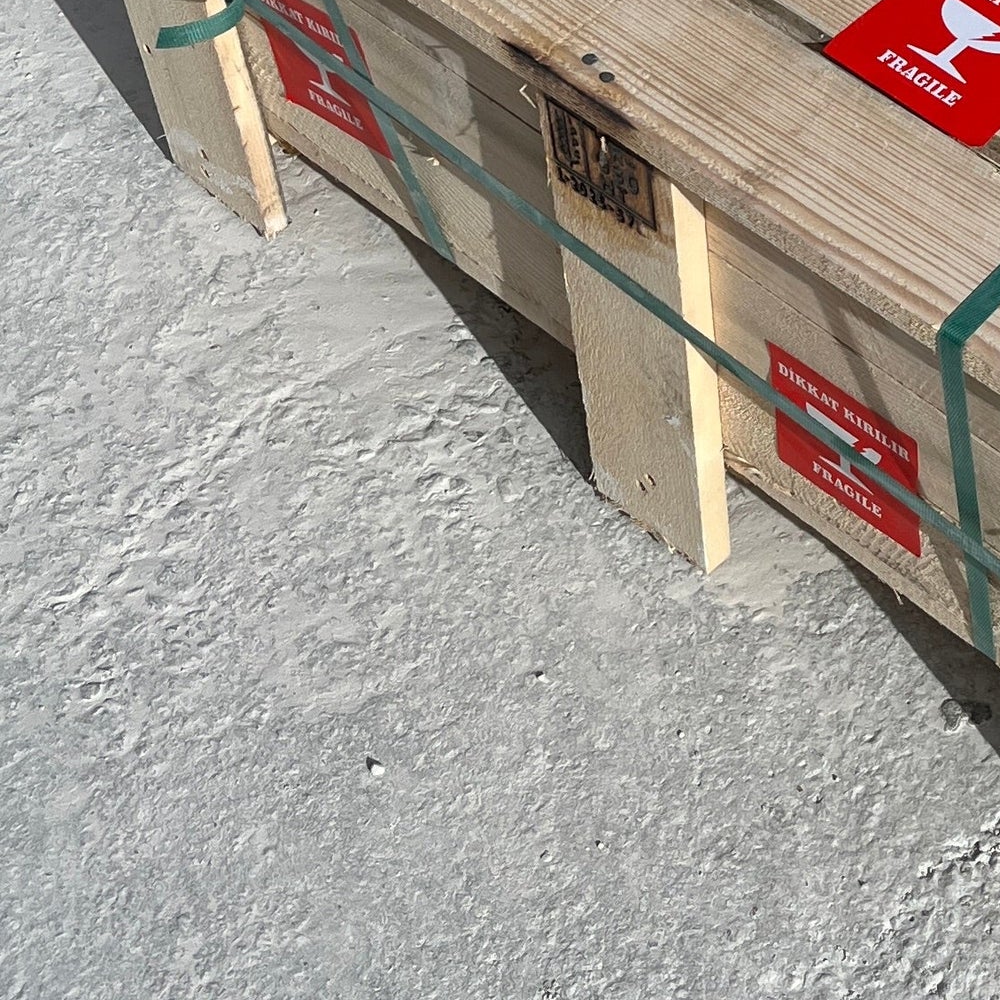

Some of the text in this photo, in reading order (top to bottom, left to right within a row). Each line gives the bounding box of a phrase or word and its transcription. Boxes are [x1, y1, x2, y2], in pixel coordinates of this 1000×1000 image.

[305, 16, 344, 48] KIRIL
[877, 49, 963, 107] FRAGILE
[308, 89, 363, 131] FRAGILE
[778, 362, 911, 462] DİKKAT KIRILIR
[812, 461, 882, 519] FRAGILE
